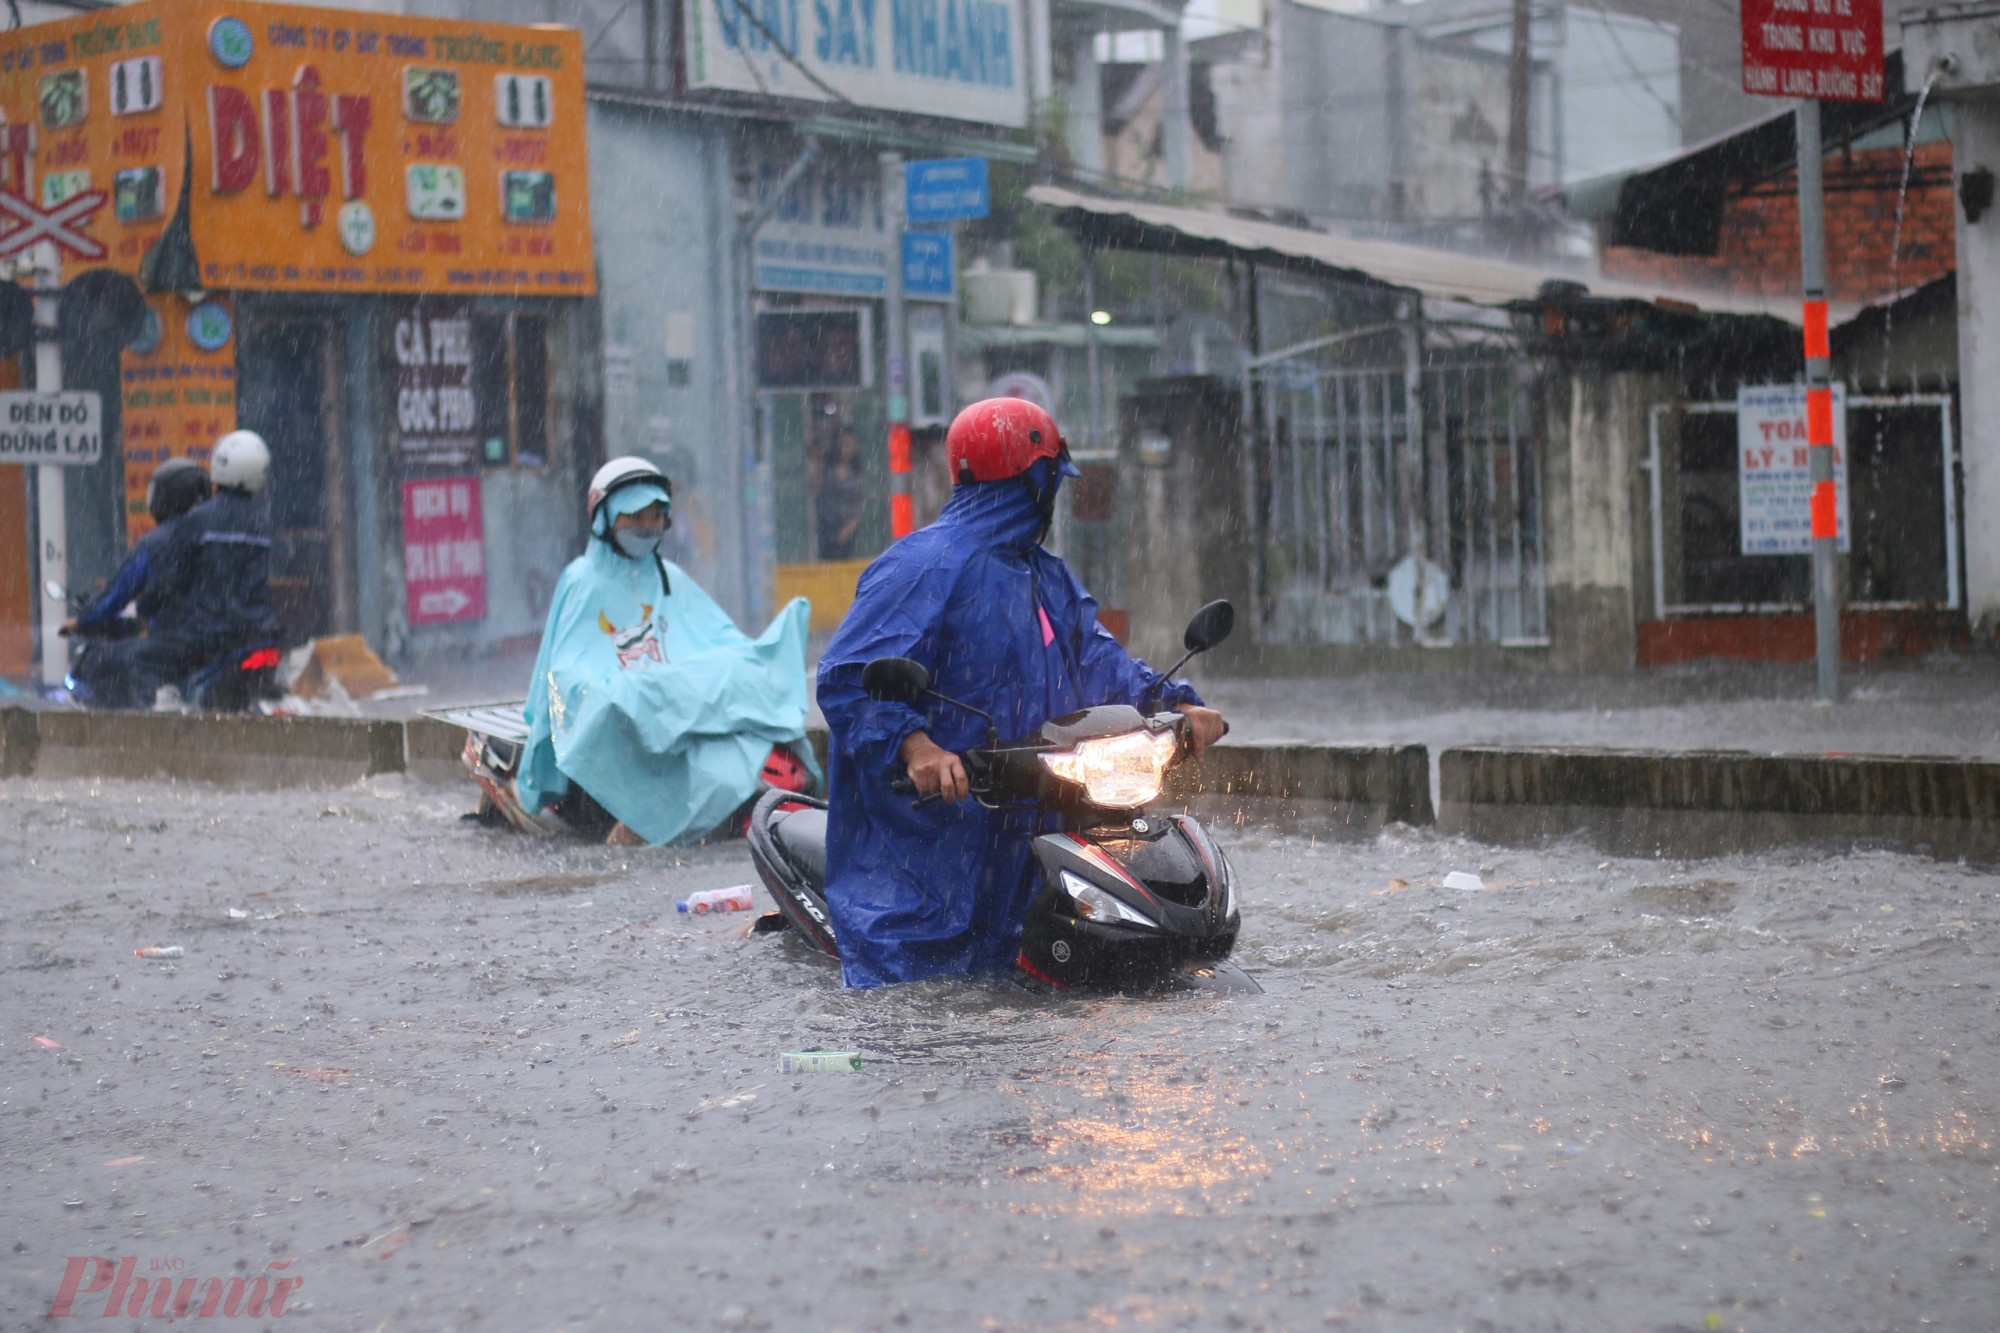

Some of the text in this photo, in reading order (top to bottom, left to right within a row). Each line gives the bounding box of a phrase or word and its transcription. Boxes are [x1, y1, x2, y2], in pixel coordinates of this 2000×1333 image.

[1762, 22, 1803, 50] TRONG
[1808, 26, 1836, 54] KHU
[1781, 66, 1815, 95] LANG
[206, 66, 372, 230] DIỆT
[64, 433, 98, 462] LẠI
